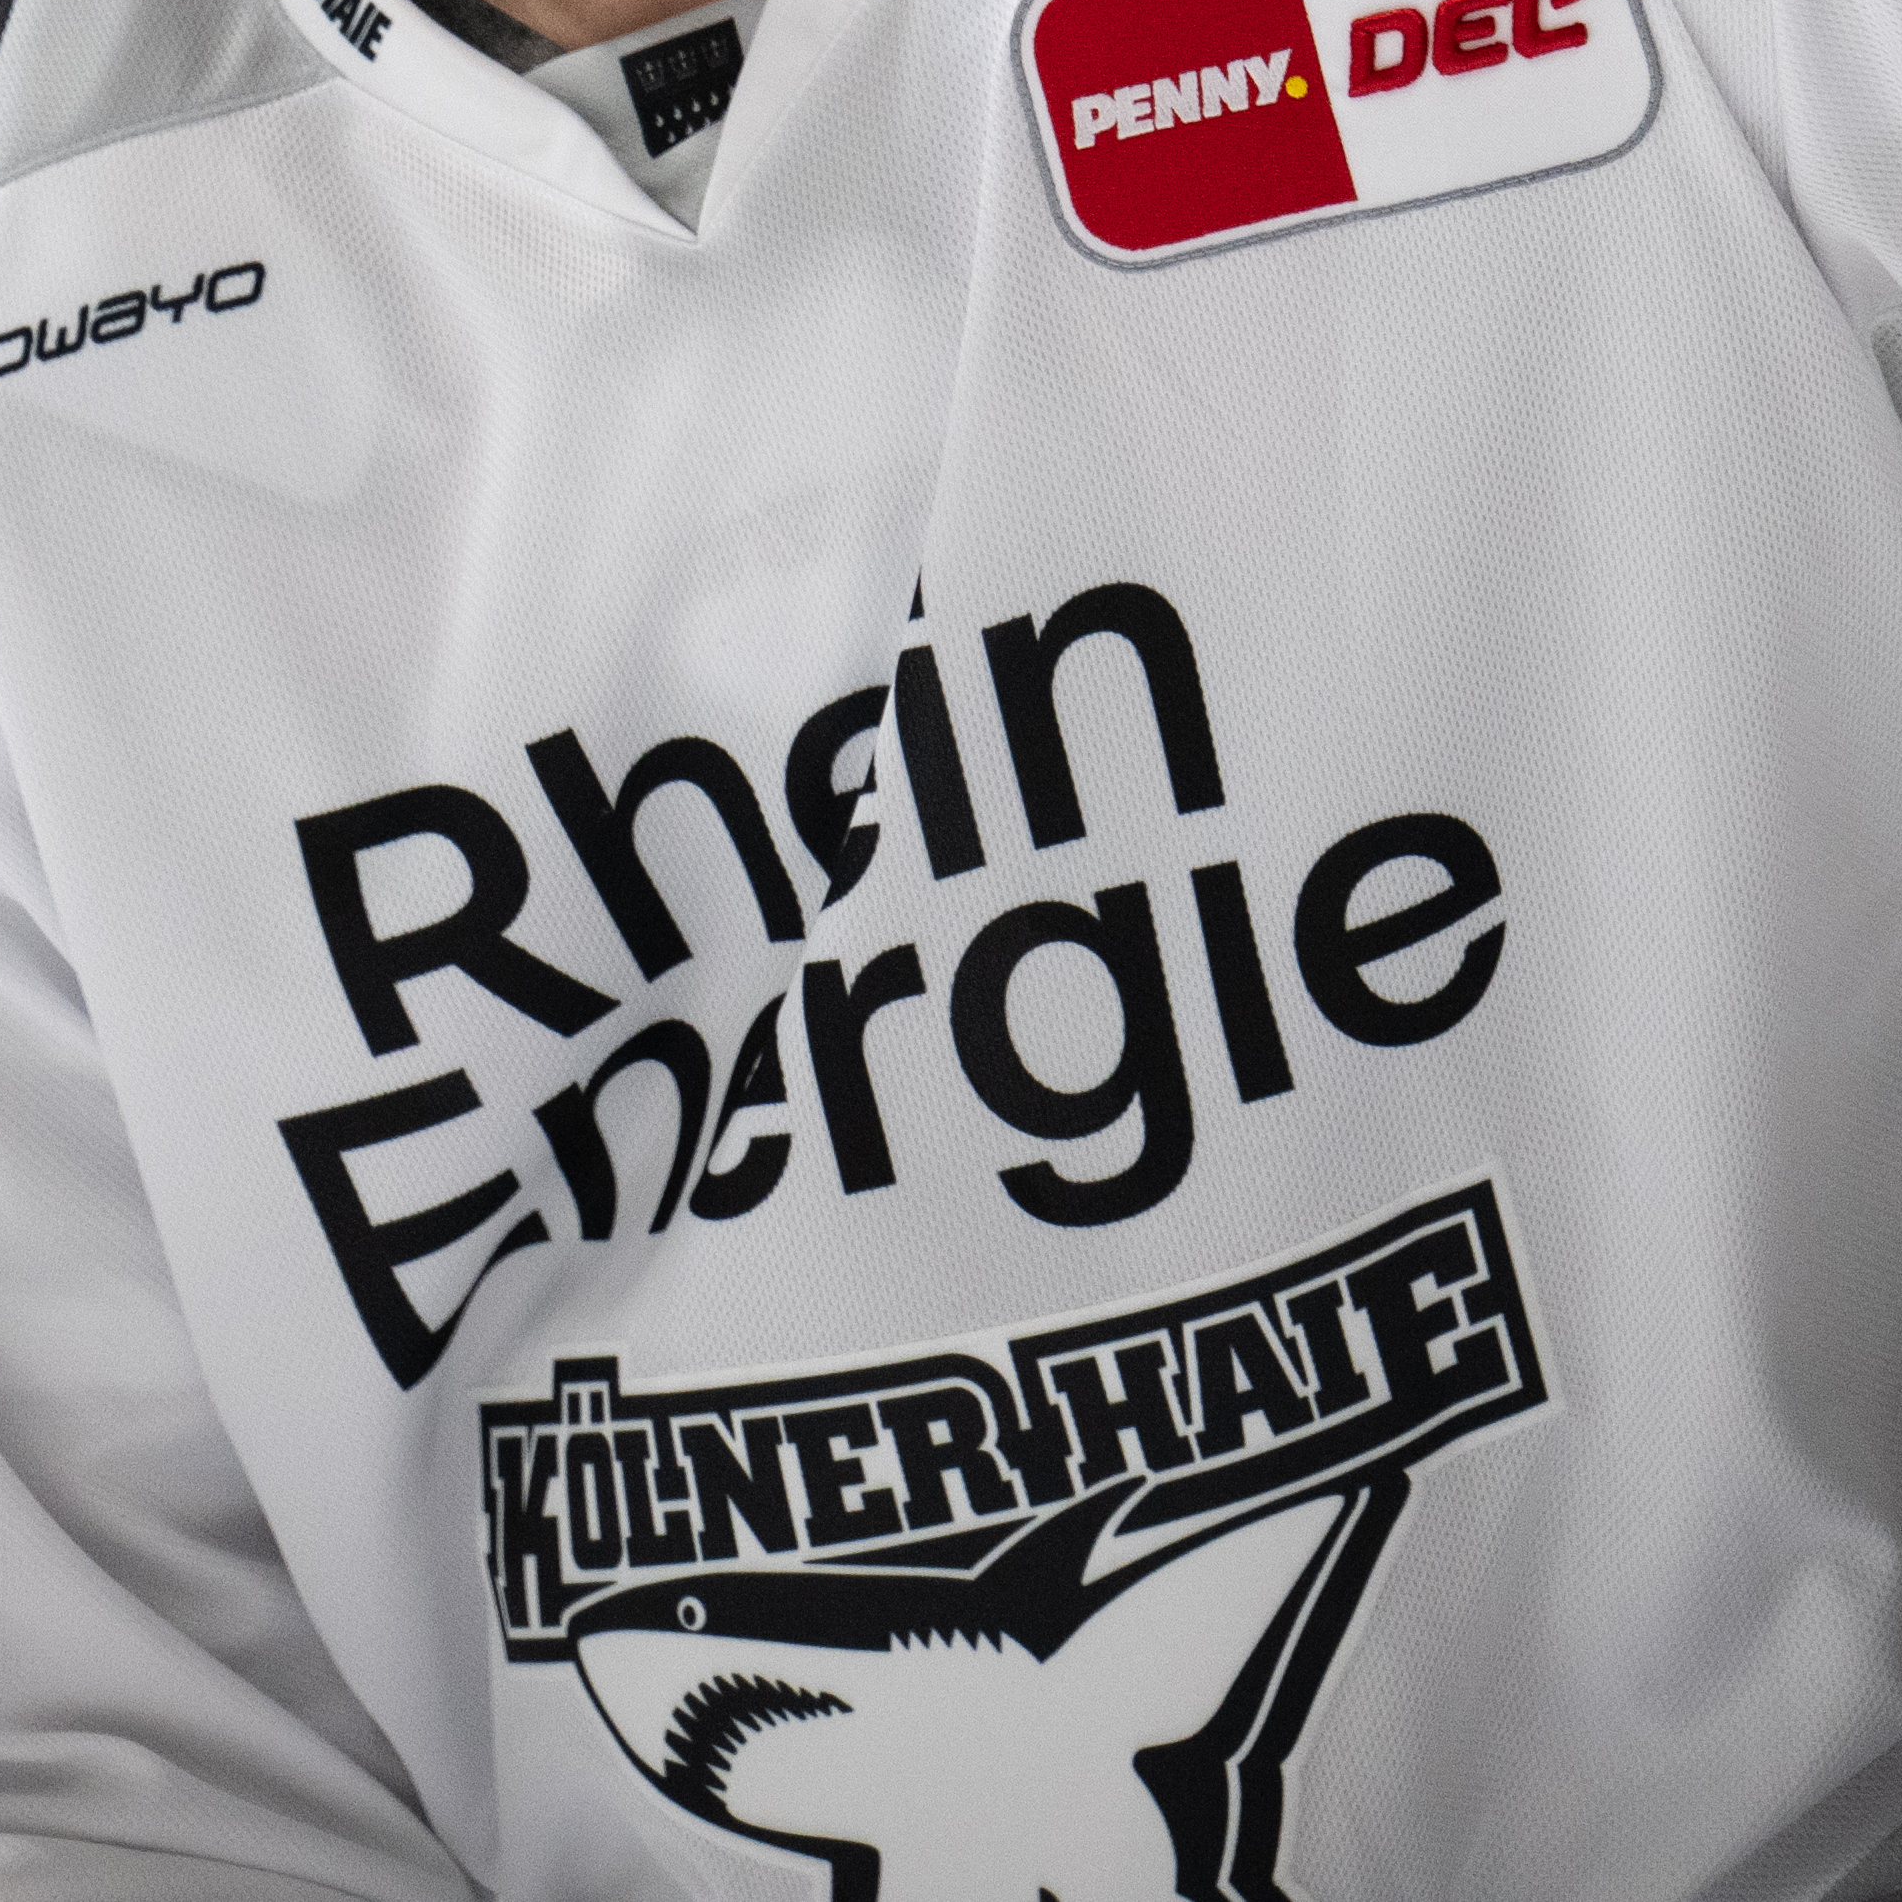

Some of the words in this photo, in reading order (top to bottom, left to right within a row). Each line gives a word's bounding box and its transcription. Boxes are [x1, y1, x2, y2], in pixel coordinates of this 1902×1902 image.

[294, 566, 1227, 1059] Rhein
[496, 1383, 1021, 1632] KÖLNER
[1048, 1218, 1518, 1496] HAIE
